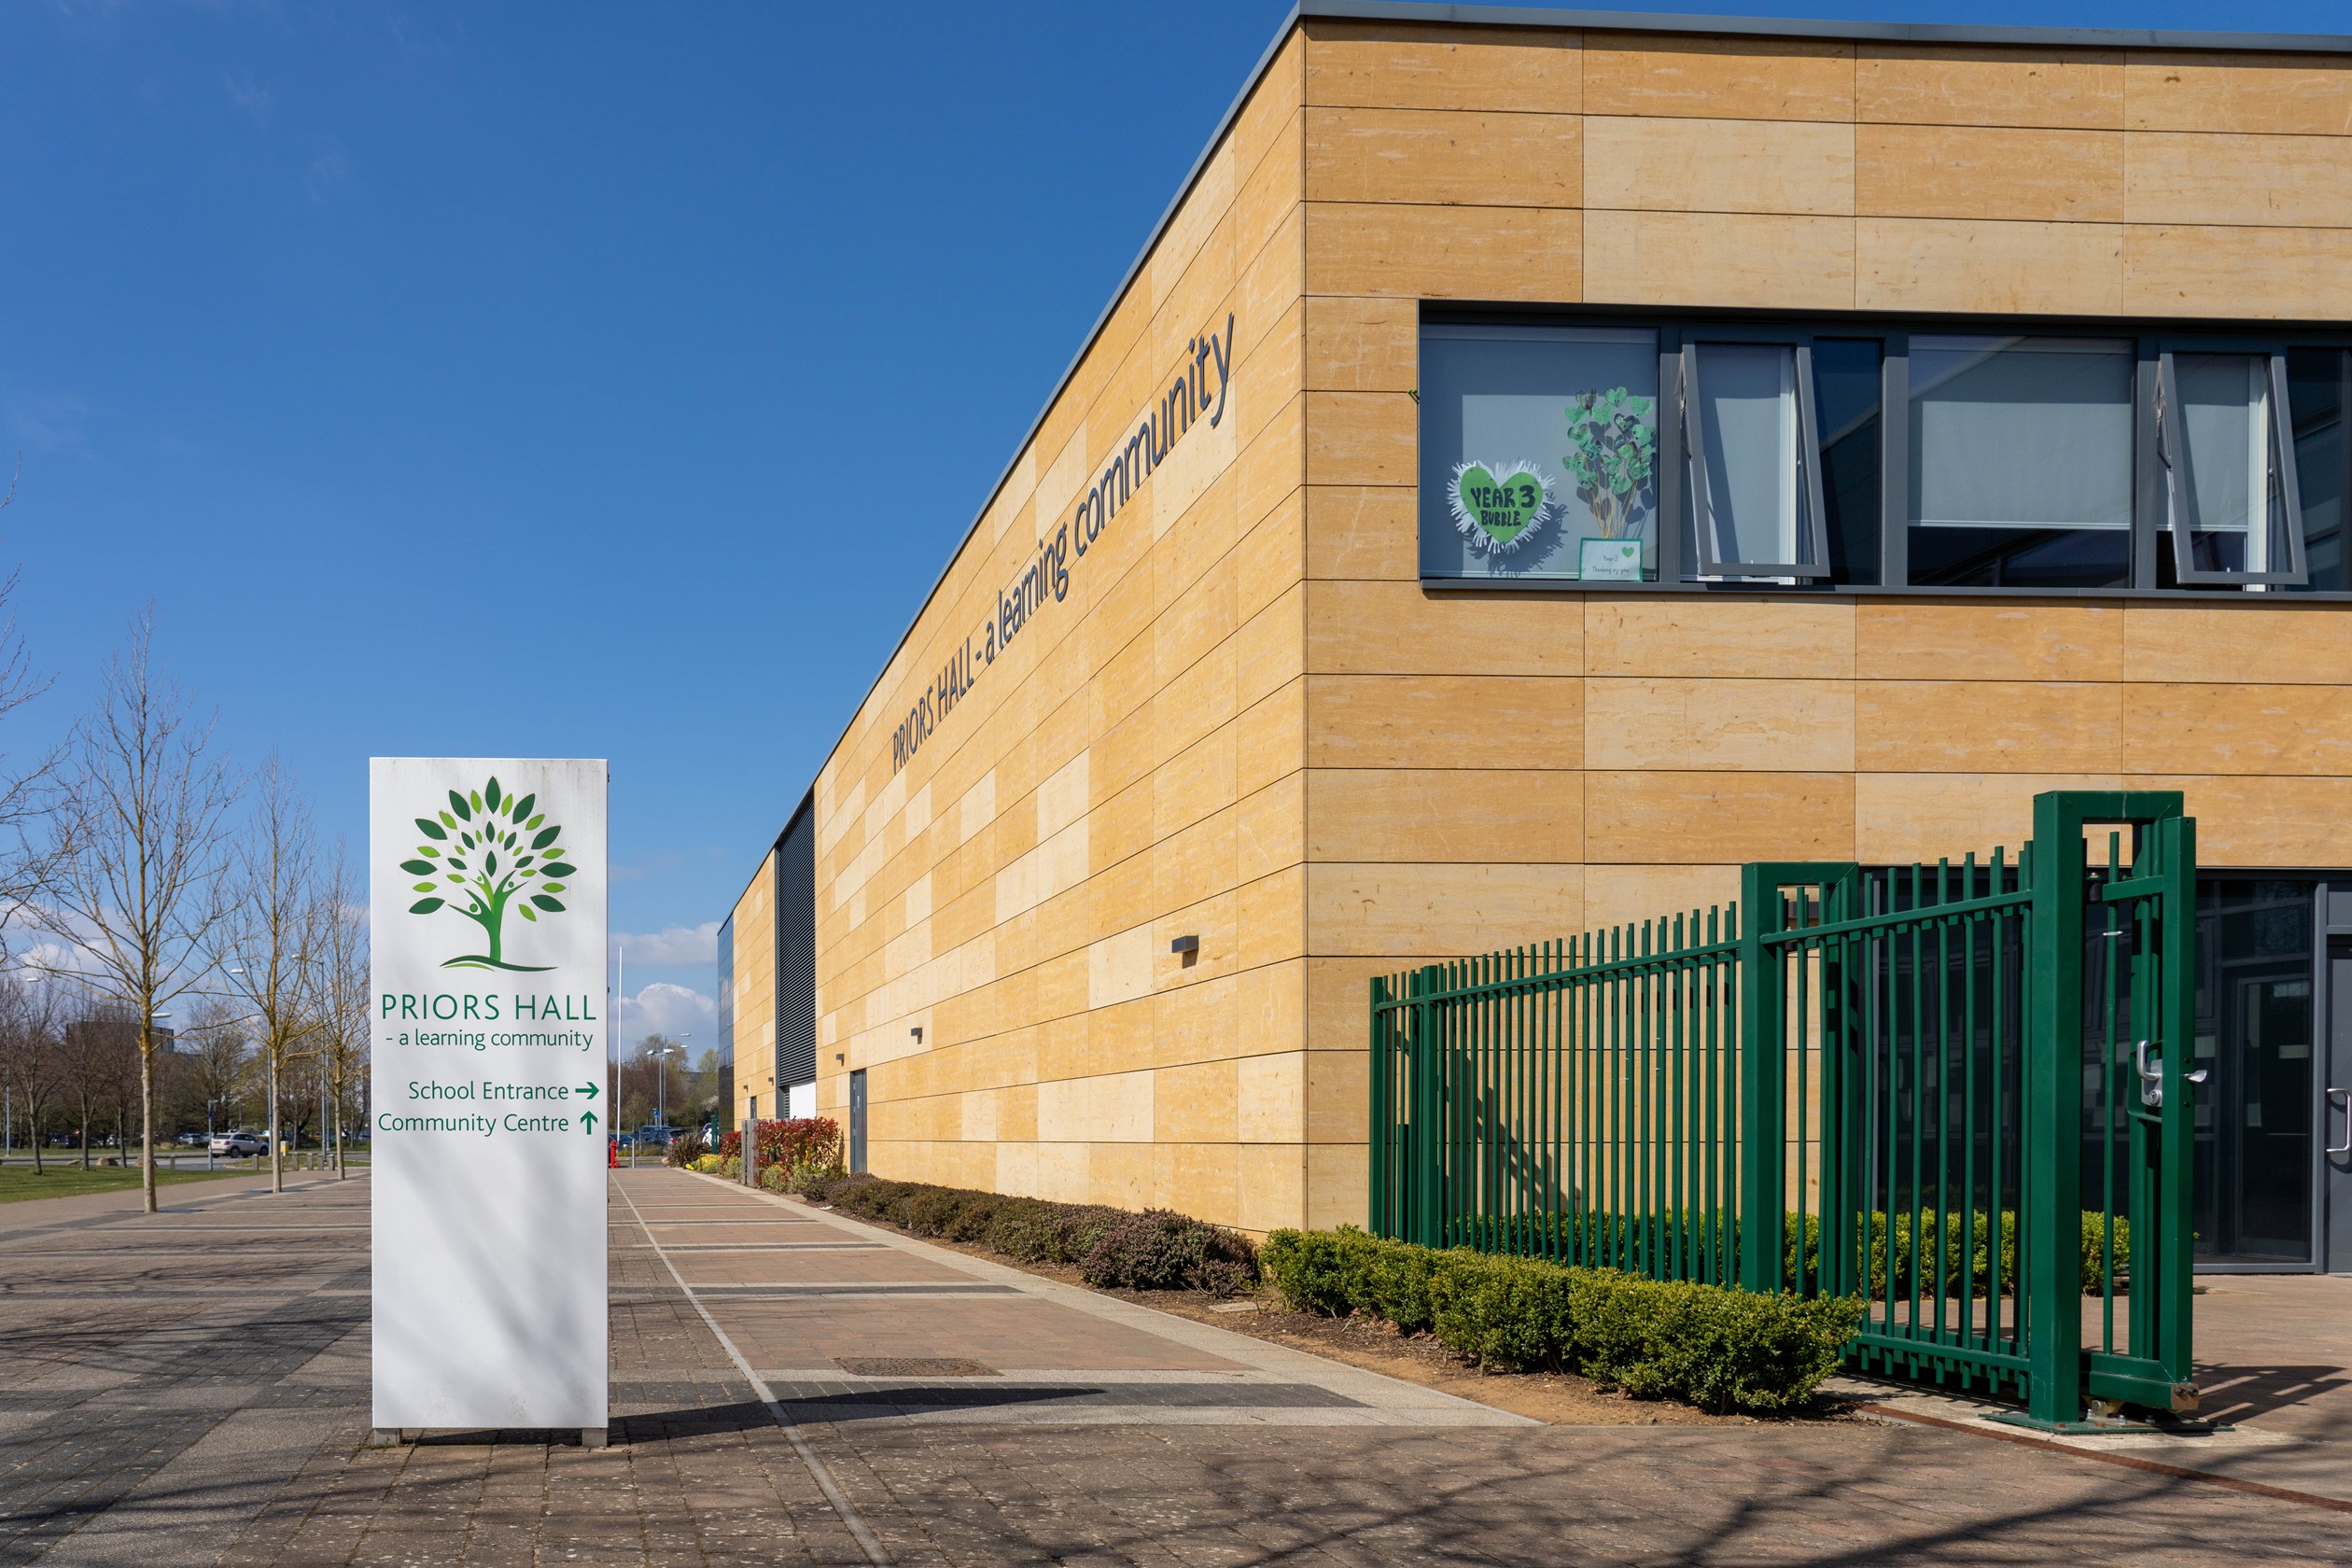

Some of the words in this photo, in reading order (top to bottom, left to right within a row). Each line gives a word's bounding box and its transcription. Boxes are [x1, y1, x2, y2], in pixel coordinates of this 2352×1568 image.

[1470, 486, 1516, 508] YEAR
[1519, 484, 1536, 508] 3
[1480, 510, 1522, 527] BUBBLE
[892, 685, 934, 776] PRIORS
[937, 637, 974, 722] HALL
[985, 620, 995, 665] a
[998, 520, 1070, 651] learning
[1074, 311, 1235, 557] community
[1592, 567, 1612, 575] Thinking
[382, 993, 500, 1021] PRIORS
[515, 994, 596, 1020] HALL
[399, 1032, 409, 1046] a
[415, 1028, 486, 1051] learning
[490, 1029, 594, 1052] community
[408, 1080, 475, 1100] School
[483, 1081, 569, 1100] Entrance
[378, 1113, 497, 1138] Community
[503, 1113, 569, 1132] Centre
